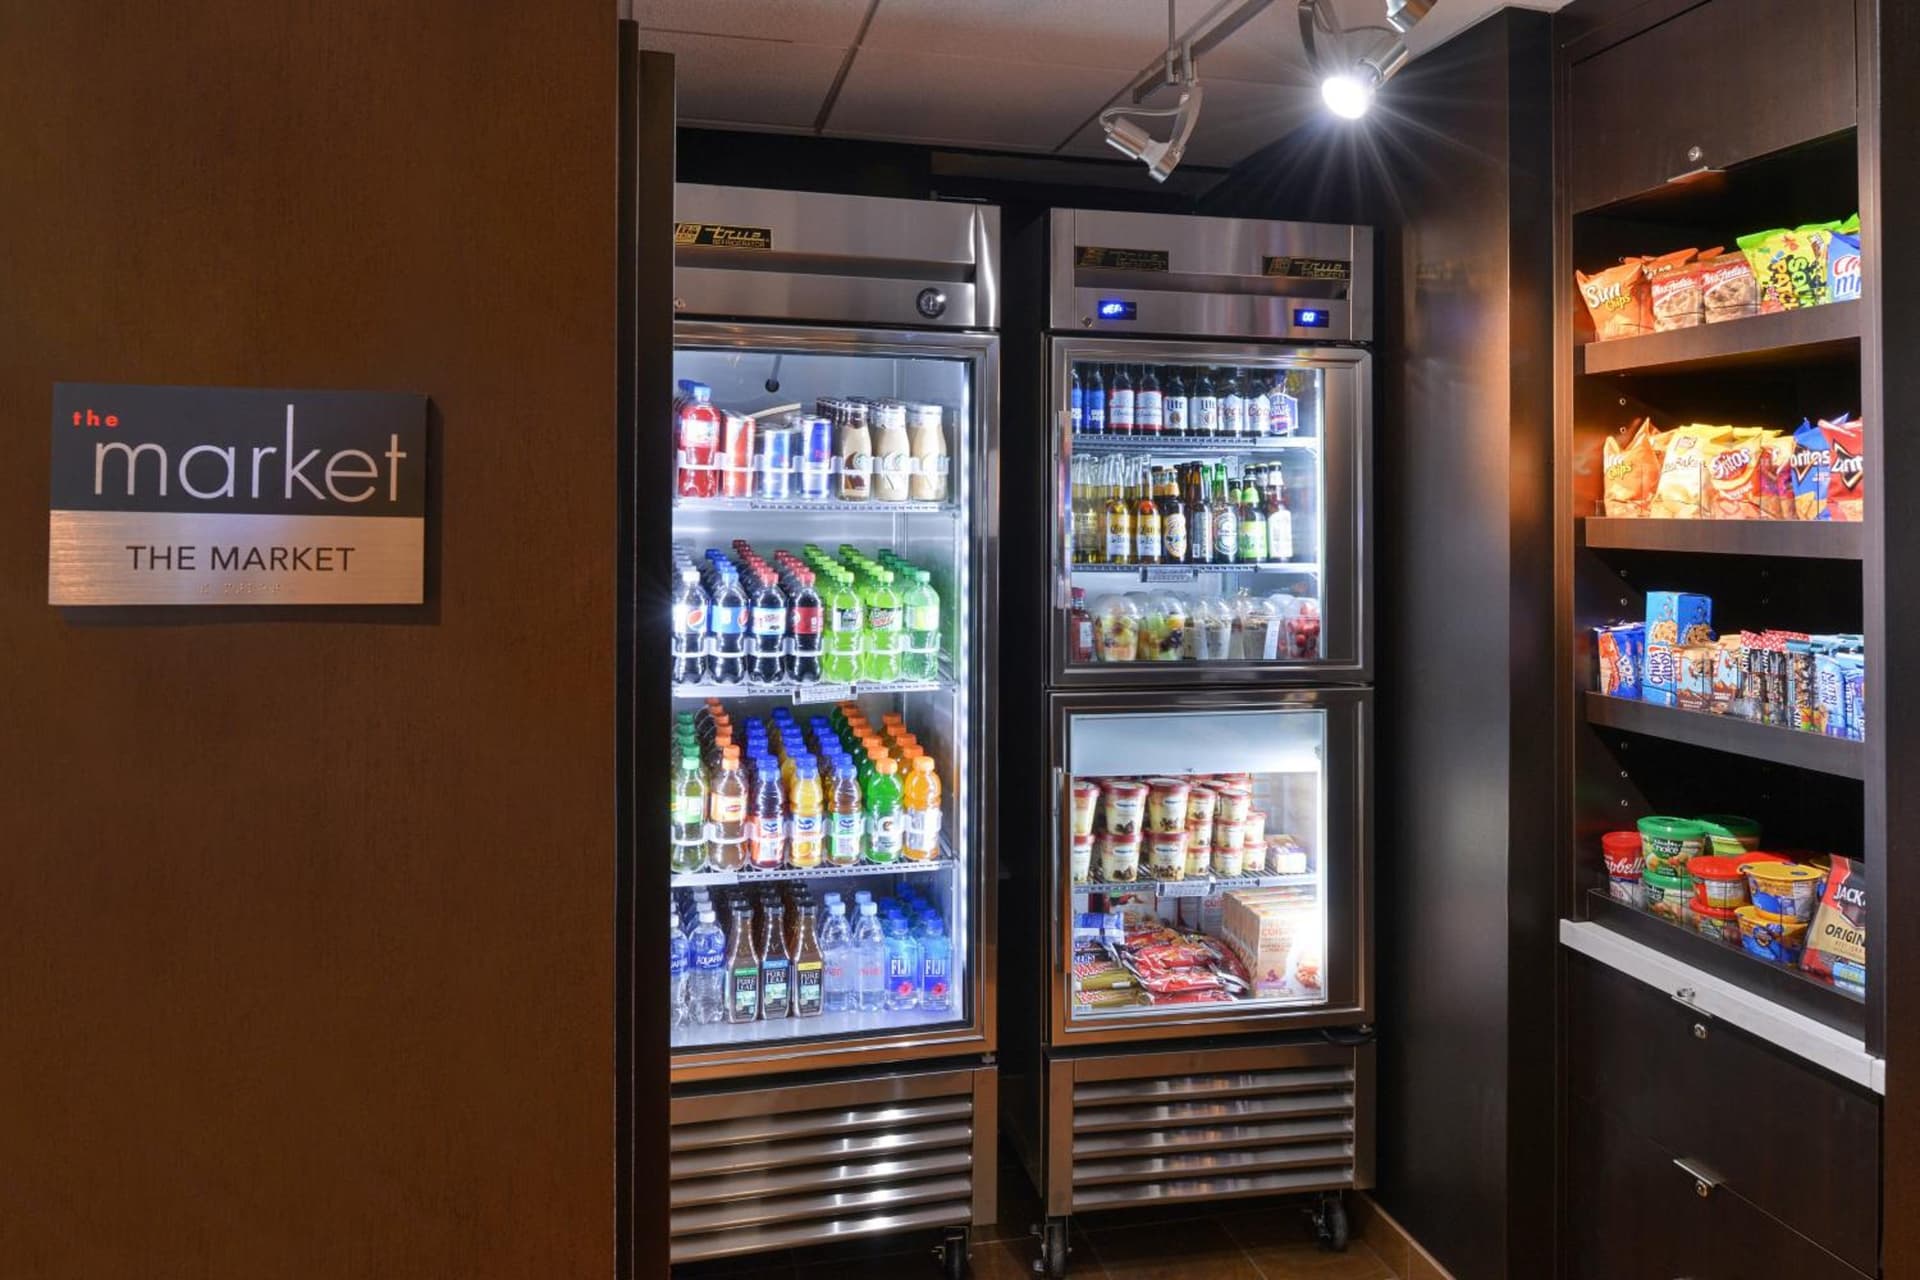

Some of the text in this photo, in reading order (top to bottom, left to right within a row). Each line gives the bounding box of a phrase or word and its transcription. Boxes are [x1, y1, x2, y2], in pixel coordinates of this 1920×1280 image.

[1586, 282, 1621, 309] Sun
[72, 409, 119, 428] the
[94, 403, 407, 502] market
[1711, 447, 1751, 480] Fritos
[1790, 450, 1830, 468] oritos
[126, 545, 356, 573] THE MARKET
[1650, 653, 1663, 685] Chips
[1833, 884, 1865, 906] JACK
[1825, 924, 1866, 947] ORIGIN
[890, 959, 912, 976] FIJI
[925, 959, 946, 976] FIJI
